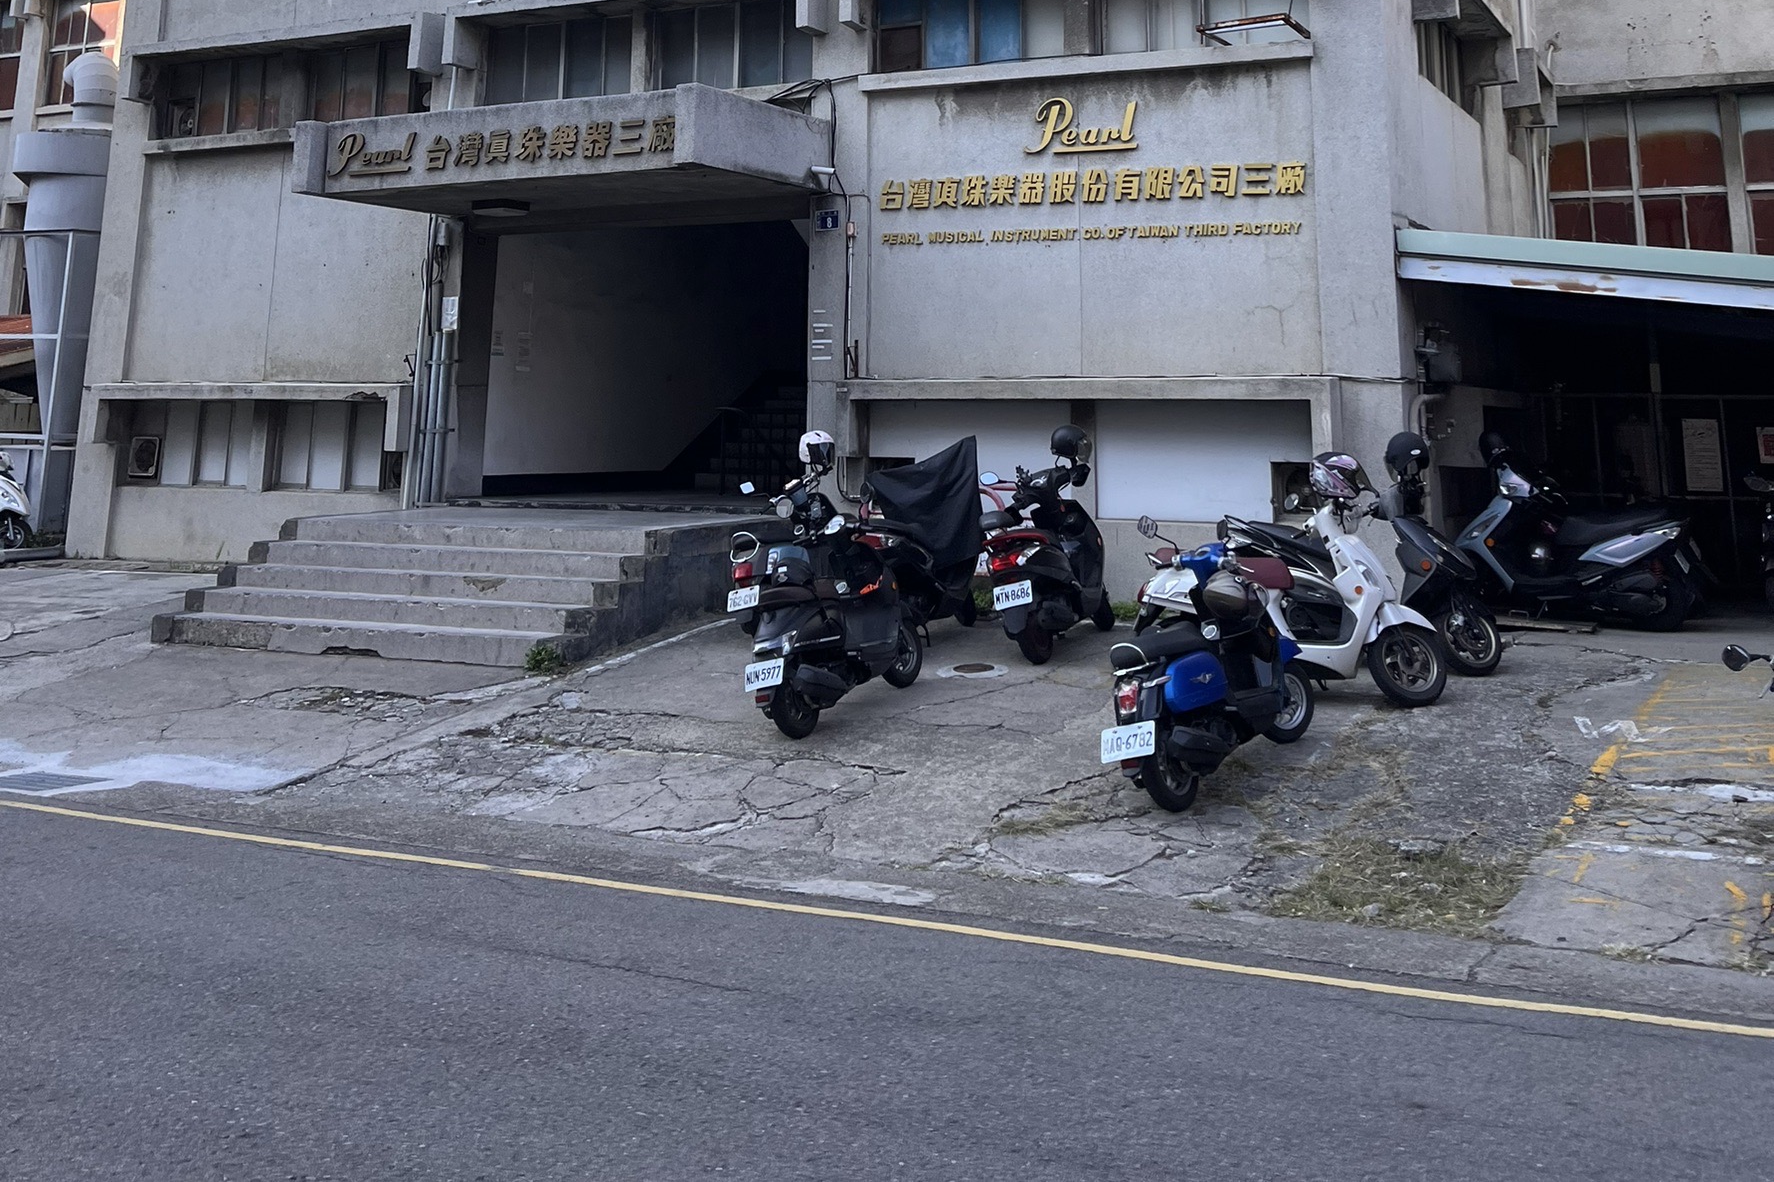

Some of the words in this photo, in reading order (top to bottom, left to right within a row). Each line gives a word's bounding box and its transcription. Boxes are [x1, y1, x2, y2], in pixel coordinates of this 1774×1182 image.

[1024, 97, 1138, 154] Pearl
[327, 132, 417, 177] Pearl
[826, 216, 833, 228] 8
[881, 232, 923, 245] PEARL
[928, 230, 984, 243] MUSICAL
[990, 228, 1077, 242] INSTRUMENT
[1127, 224, 1180, 239] TAIWAN
[1184, 223, 1229, 237] THIRD
[1233, 221, 1302, 236] FACTORY
